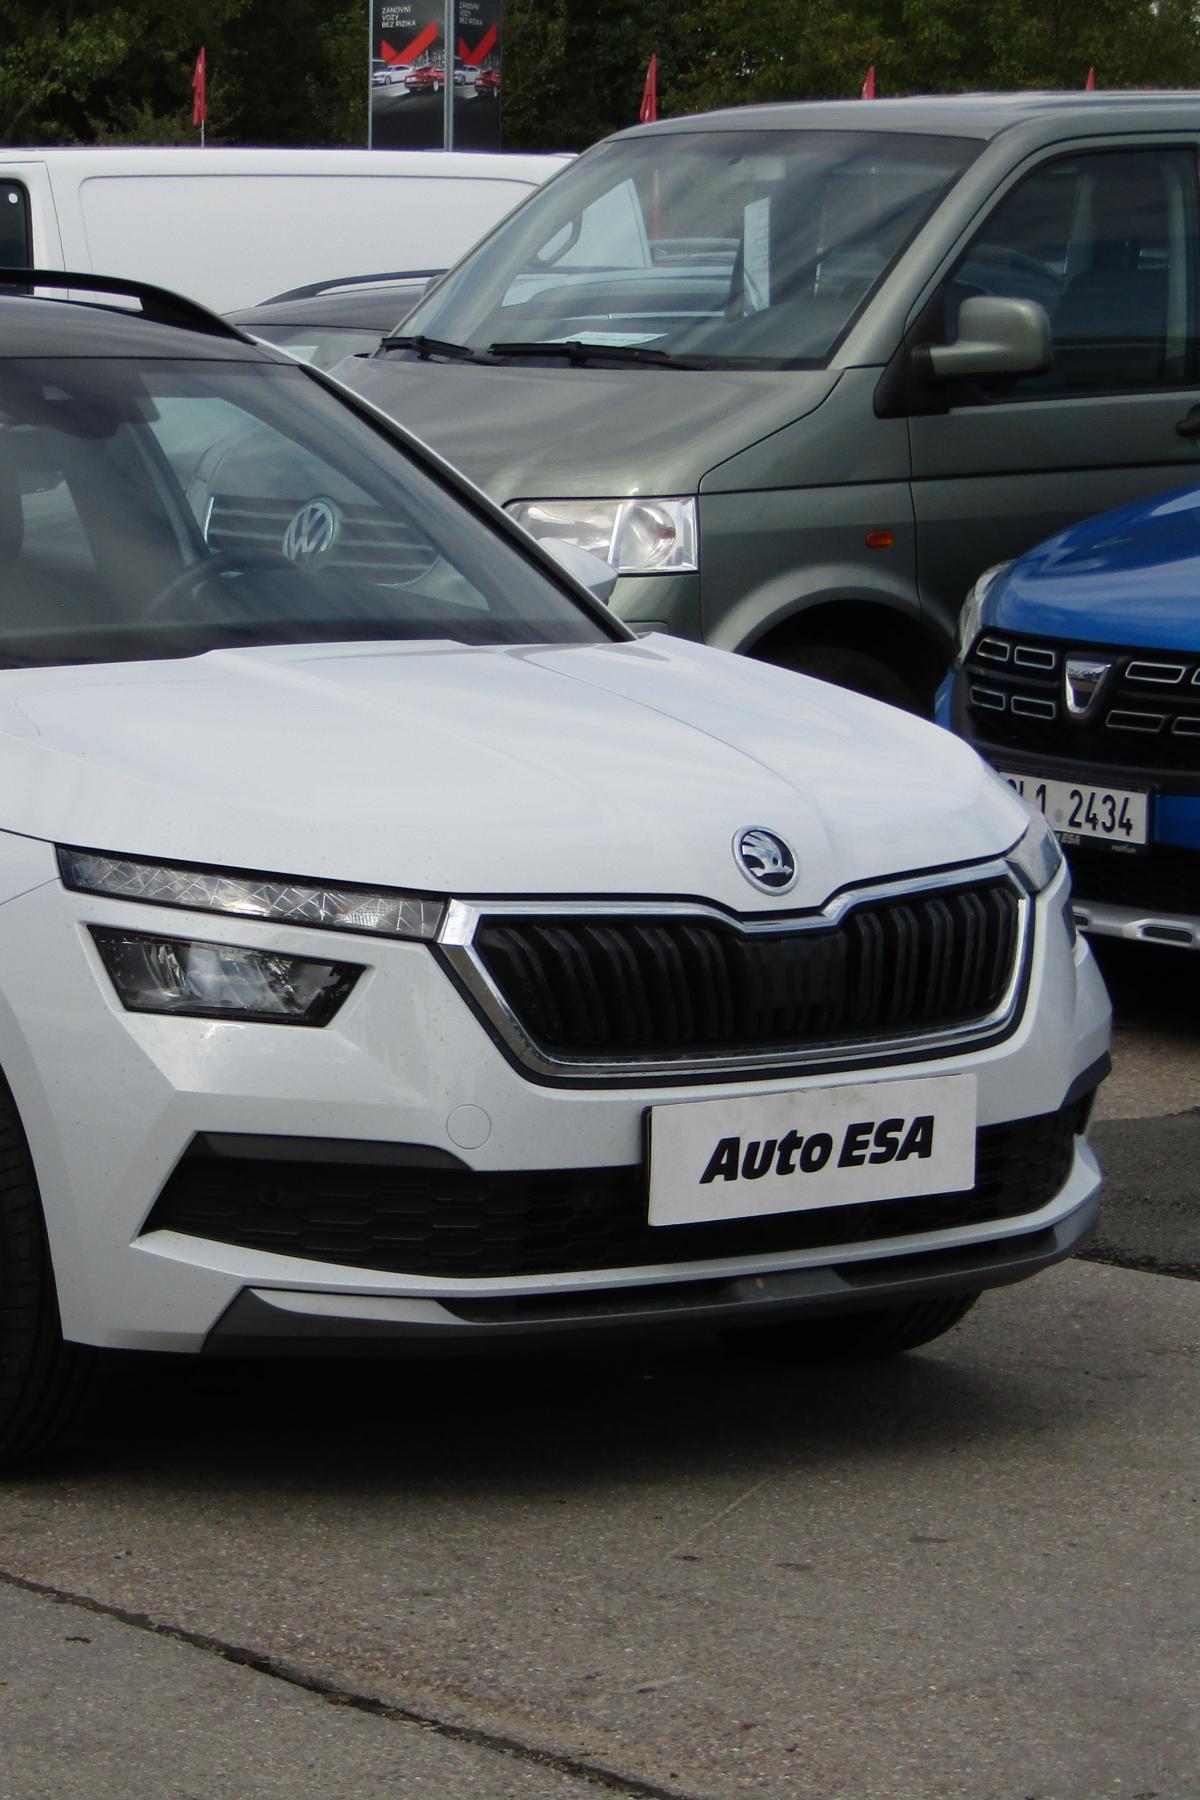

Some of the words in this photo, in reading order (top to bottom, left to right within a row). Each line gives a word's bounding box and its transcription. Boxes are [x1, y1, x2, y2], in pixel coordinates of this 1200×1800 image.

[396, 20, 417, 28] RIZIKA
[1068, 789, 1132, 837] 2434
[699, 1130, 833, 1185] Auto
[837, 1115, 935, 1169] ESA
